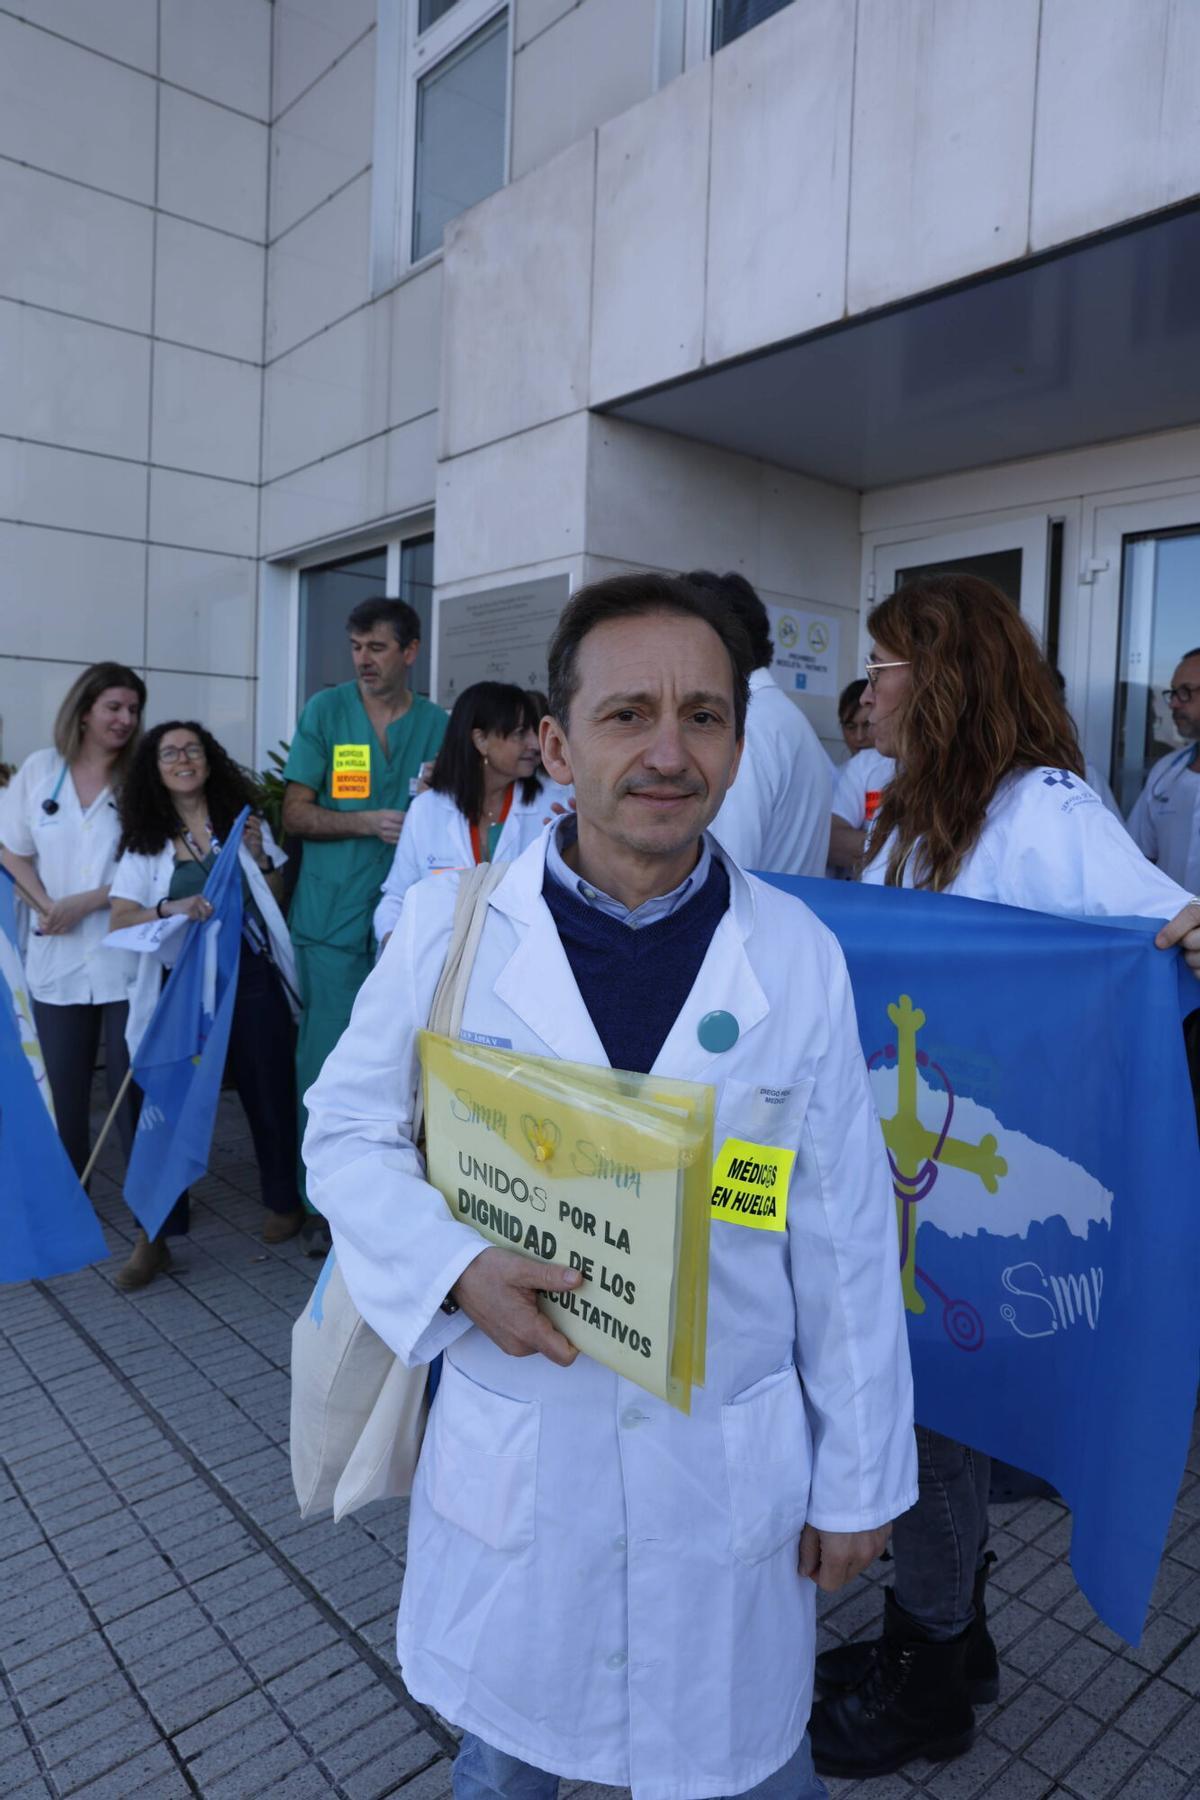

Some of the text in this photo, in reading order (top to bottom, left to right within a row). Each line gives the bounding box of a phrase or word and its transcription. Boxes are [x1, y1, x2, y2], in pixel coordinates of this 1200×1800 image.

[458, 1151, 630, 1254] UNIDOS POR LA
[711, 1186, 777, 1217] EN HUELGA
[458, 1187, 636, 1305] DIGNIDAD DE LOS
[538, 1288, 651, 1358] CULTATIVOS
